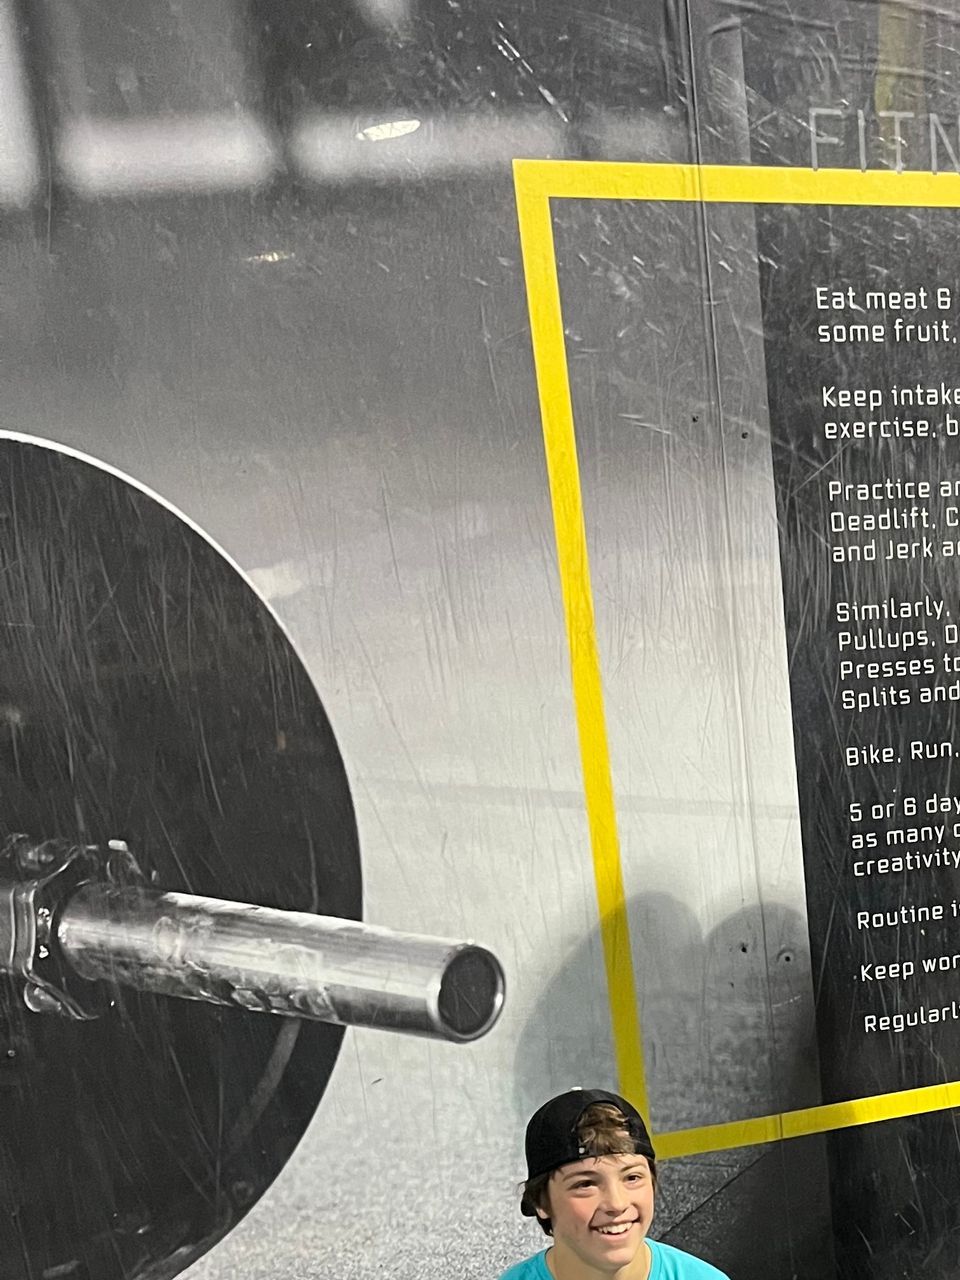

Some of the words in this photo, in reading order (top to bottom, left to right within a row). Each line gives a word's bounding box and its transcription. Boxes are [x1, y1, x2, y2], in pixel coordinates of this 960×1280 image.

[816, 287, 857, 310] Eat
[866, 287, 927, 309] meat
[818, 325, 884, 342] some
[894, 319, 956, 343] fruit,
[823, 387, 882, 411] Keep
[825, 417, 935, 438] exercise,
[829, 479, 930, 501] Practice
[831, 507, 935, 532] Deadlift,
[833, 540, 875, 562] and
[886, 537, 932, 559] Jerk
[837, 597, 950, 622] Similarly,
[839, 628, 935, 651] Pullups,
[841, 659, 934, 680] Presses
[842, 687, 910, 712] Splits
[921, 681, 960, 702] and
[846, 744, 900, 766] Bike,
[911, 741, 958, 759] Run,
[850, 804, 861, 821] 5
[872, 804, 894, 819] or
[904, 798, 916, 815] 6
[852, 833, 877, 848] as
[887, 826, 946, 849] many
[854, 850, 960, 876] creativity
[858, 907, 942, 930] Routine
[861, 962, 913, 981] Keep
